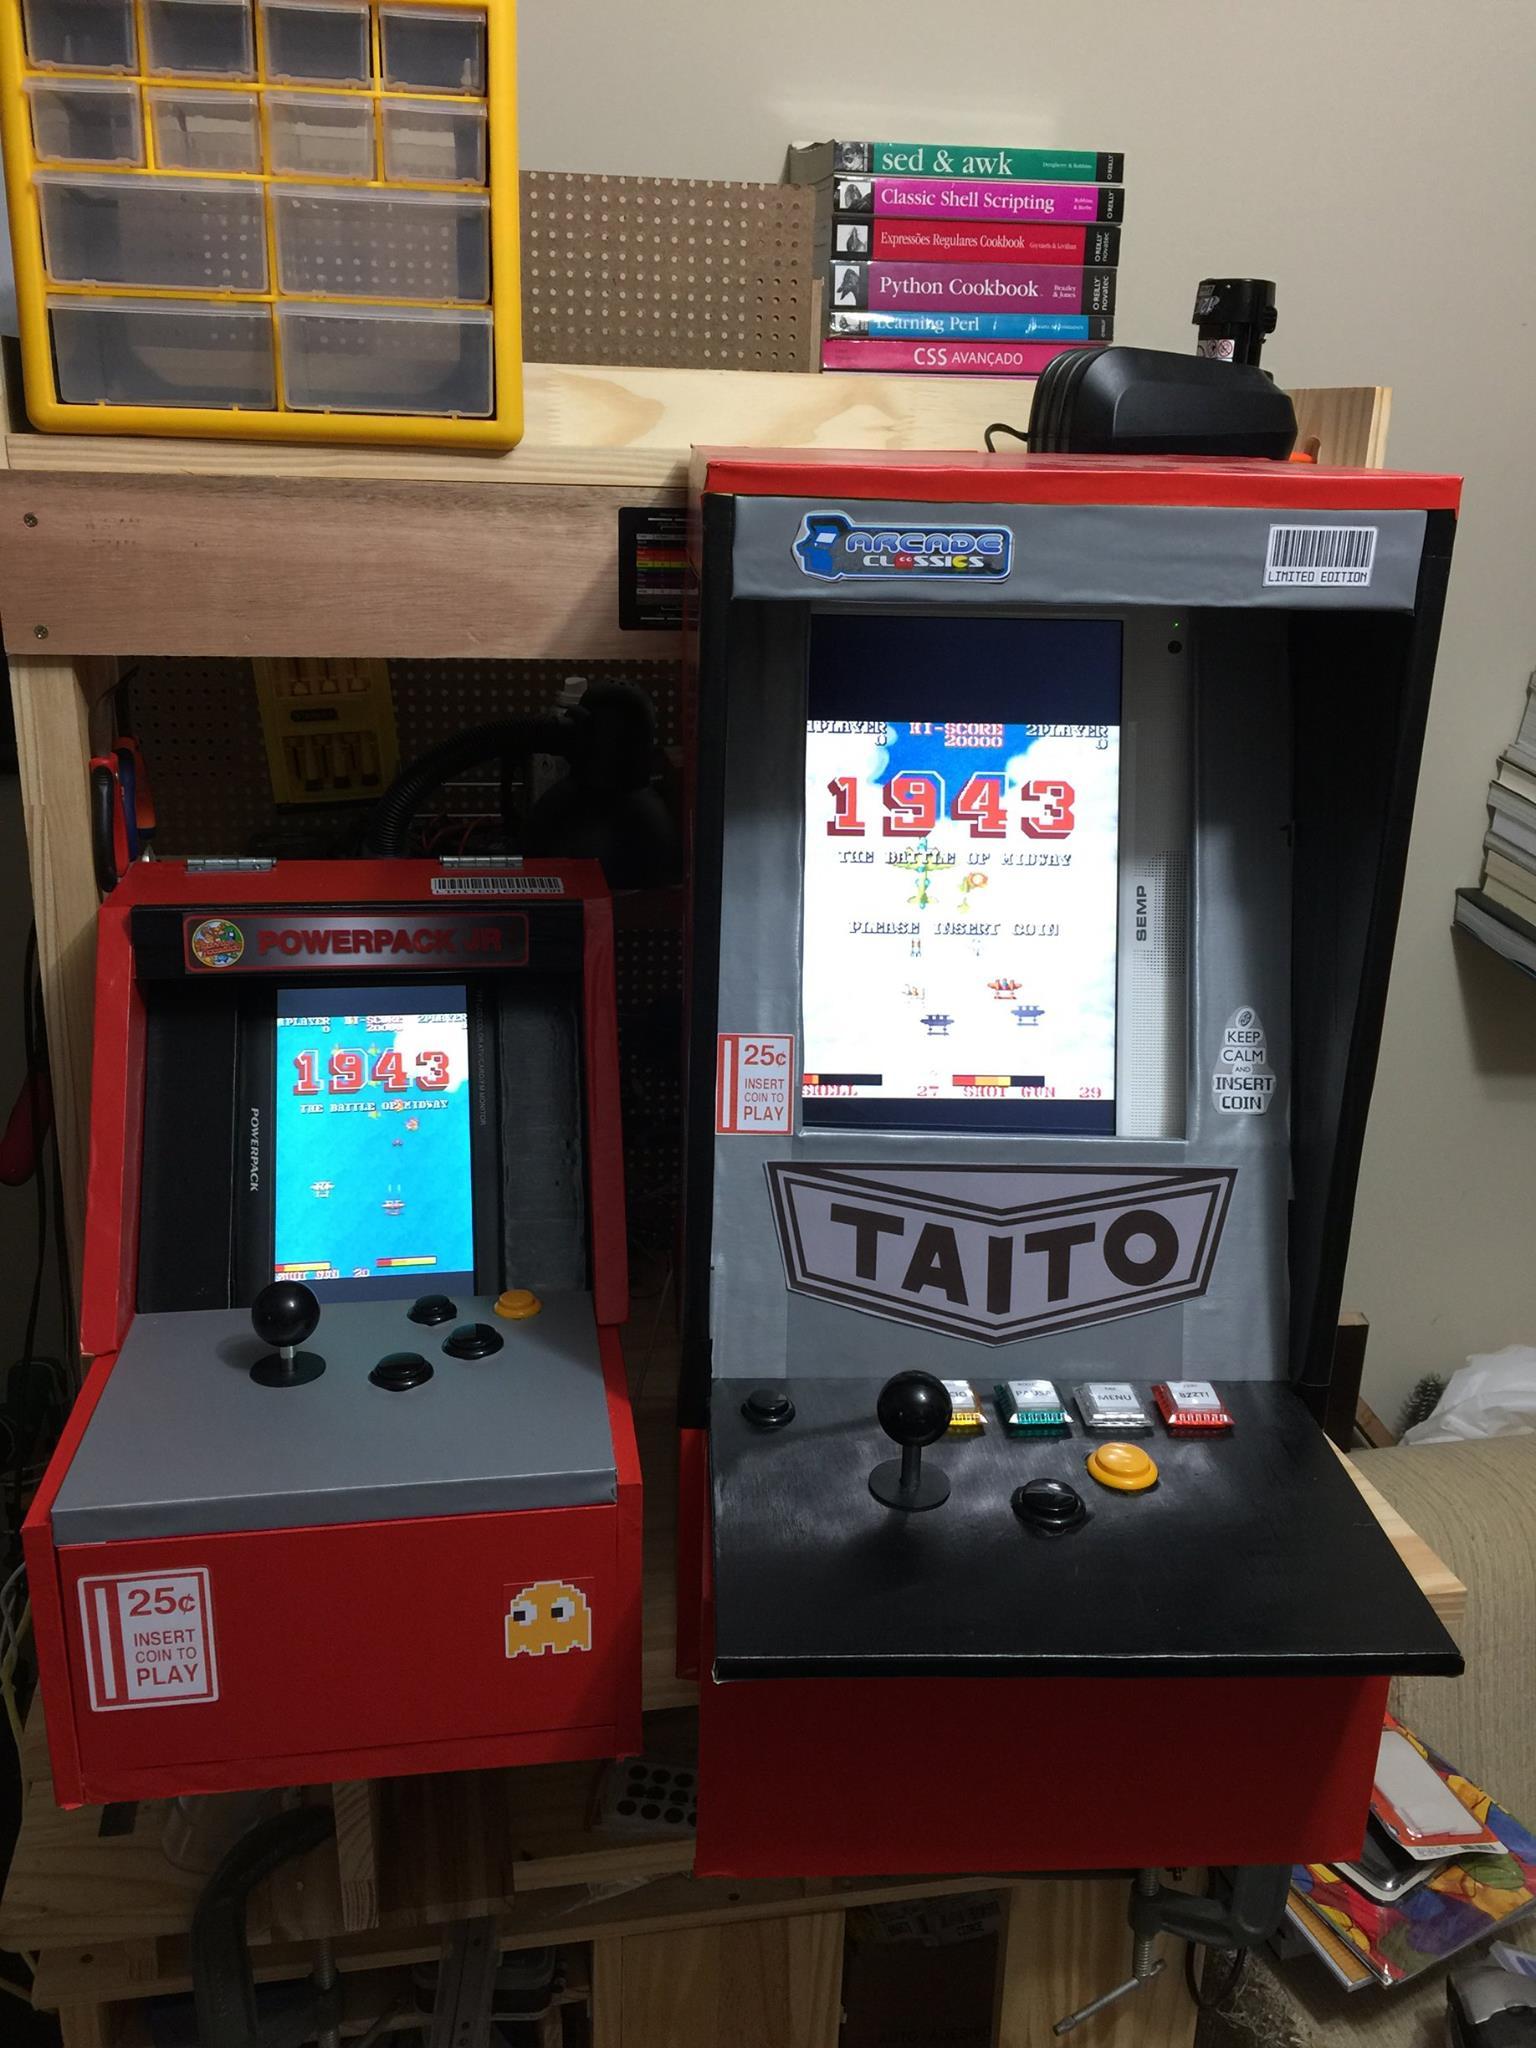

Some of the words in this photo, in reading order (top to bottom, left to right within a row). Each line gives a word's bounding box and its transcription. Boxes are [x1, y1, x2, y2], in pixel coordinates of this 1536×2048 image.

[882, 148, 923, 171] sed
[933, 150, 957, 174] &
[962, 151, 1013, 175] awk
[881, 188, 936, 207] Classic
[941, 190, 979, 208] Shell
[984, 192, 1055, 213] Scripting
[881, 232, 930, 247] Expressões
[933, 234, 978, 250] Regulares
[980, 235, 1025, 249] Cookbook
[1102, 232, 1110, 262] novatec
[880, 277, 942, 298] Python
[949, 279, 1039, 298] Cookbook
[1101, 276, 1109, 312] novatec
[949, 316, 980, 331] Perl
[914, 347, 948, 366] CSS
[952, 352, 1023, 367] AVANÇADO
[846, 532, 1004, 555] ARCADE
[1268, 571, 1315, 583] LIMITED
[1321, 571, 1368, 583] EDITION
[909, 722, 1004, 736] HI-SCORE
[944, 735, 1004, 748] 20000
[827, 771, 1076, 840] 1943
[839, 851, 874, 864] THE
[885, 851, 956, 866] BATTLE
[967, 852, 990, 866] OF
[1001, 853, 1073, 867] MIDWAY
[1136, 886, 1148, 942] SEMP
[848, 921, 920, 935] PLEASE
[258, 928, 457, 957] POWERPACK
[1228, 1031, 1261, 1043] KEEP
[744, 1044, 787, 1067] 25¢
[1223, 1050, 1263, 1062] CALM
[294, 1048, 450, 1095] 1943
[745, 1078, 785, 1090] INSERT
[916, 1086, 939, 1097] 27
[1079, 1087, 1102, 1099] 29
[1216, 1077, 1273, 1091] INSERT
[744, 1092, 768, 1103] COIN
[771, 1093, 784, 1103] TO
[1222, 1096, 1262, 1110] COIN
[301, 1104, 323, 1113] THE
[330, 1102, 376, 1112] BATTLE
[743, 1105, 784, 1121] PLAY
[250, 1107, 260, 1192] POWERPACK
[830, 1203, 1180, 1315] TAITO
[1098, 1393, 1132, 1401] MENU
[128, 1586, 196, 1617] 25¢
[134, 1629, 195, 1647] INSERT
[135, 1649, 172, 1664] COIN
[177, 1647, 197, 1660] TO
[136, 1663, 198, 1687] PLAY
